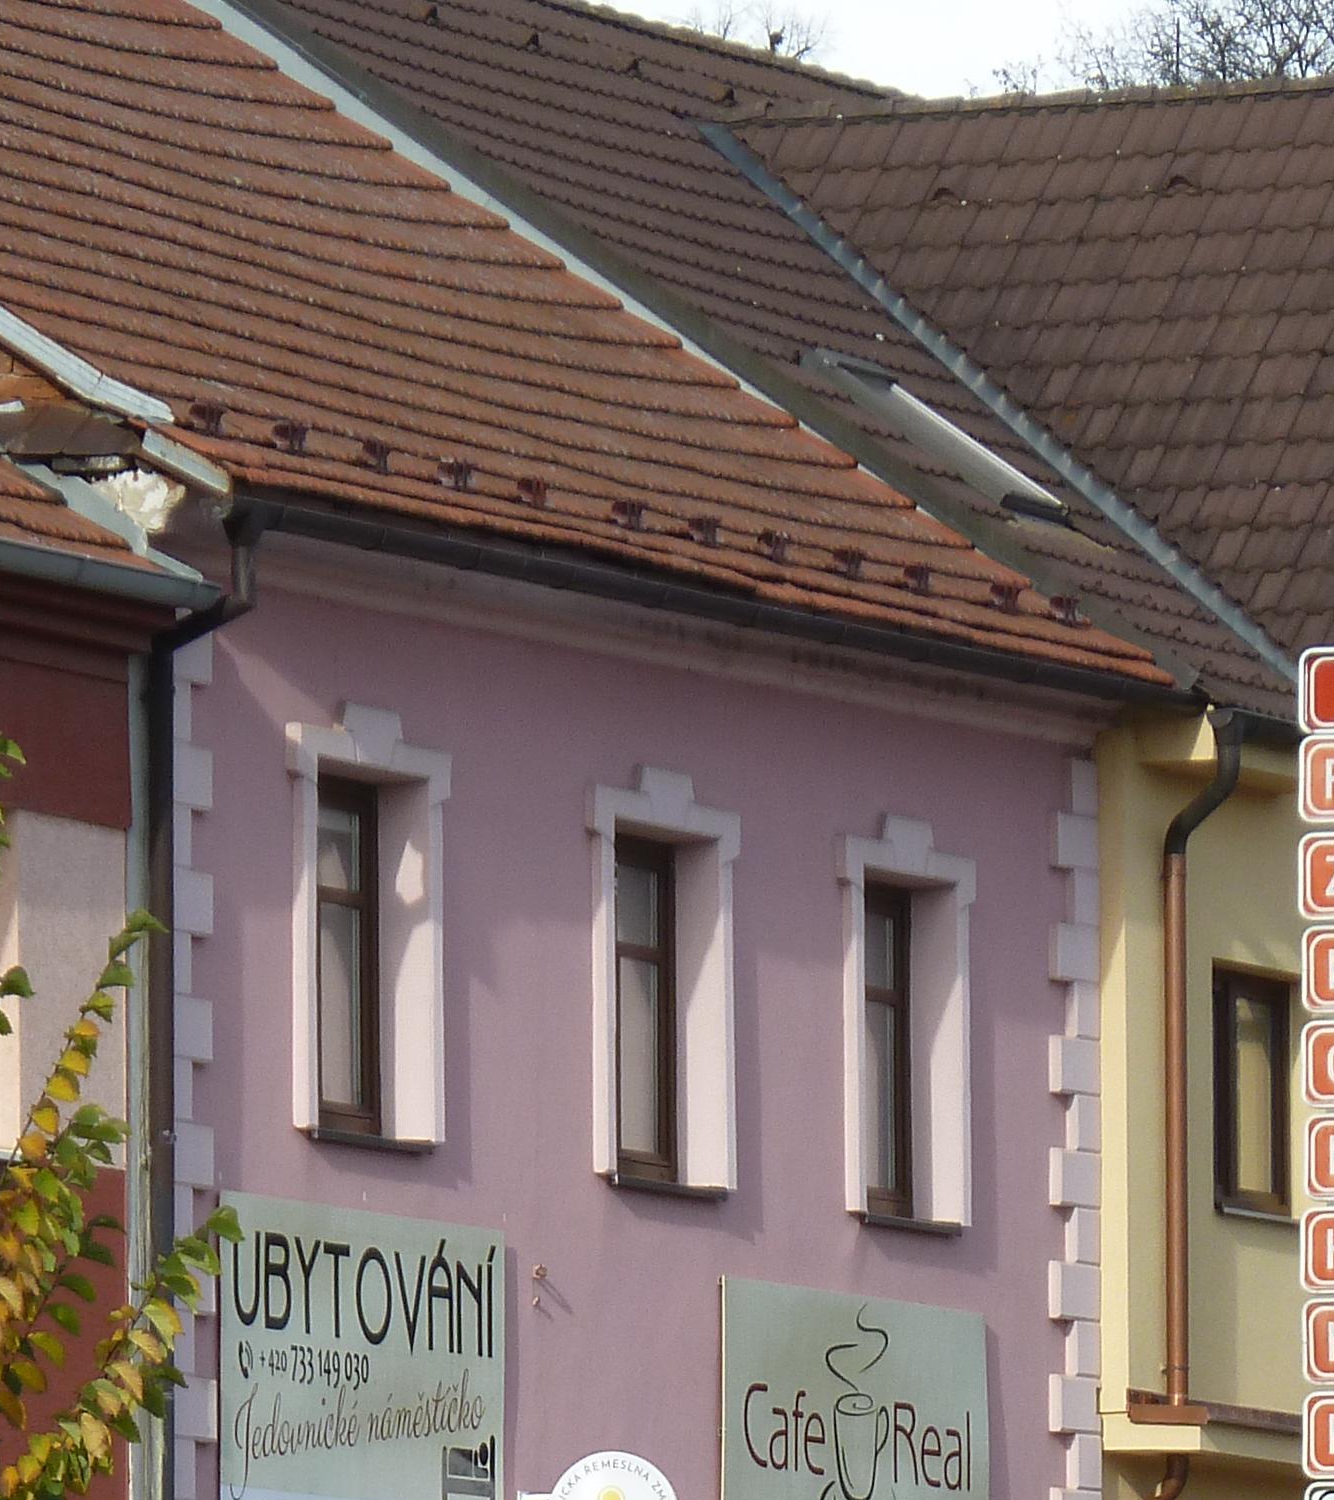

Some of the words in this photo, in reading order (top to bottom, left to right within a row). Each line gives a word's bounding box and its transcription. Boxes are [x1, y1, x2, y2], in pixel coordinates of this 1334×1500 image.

[232, 1230, 496, 1358] UBYTOVÁNÍ
[290, 1345, 314, 1385] 733
[318, 1348, 340, 1389] 149
[344, 1353, 369, 1391] 030
[229, 1382, 360, 1500] Jedovnické
[367, 1368, 485, 1443] náměstíčko
[743, 1382, 826, 1476] Cafe
[893, 1401, 971, 1492] Real
